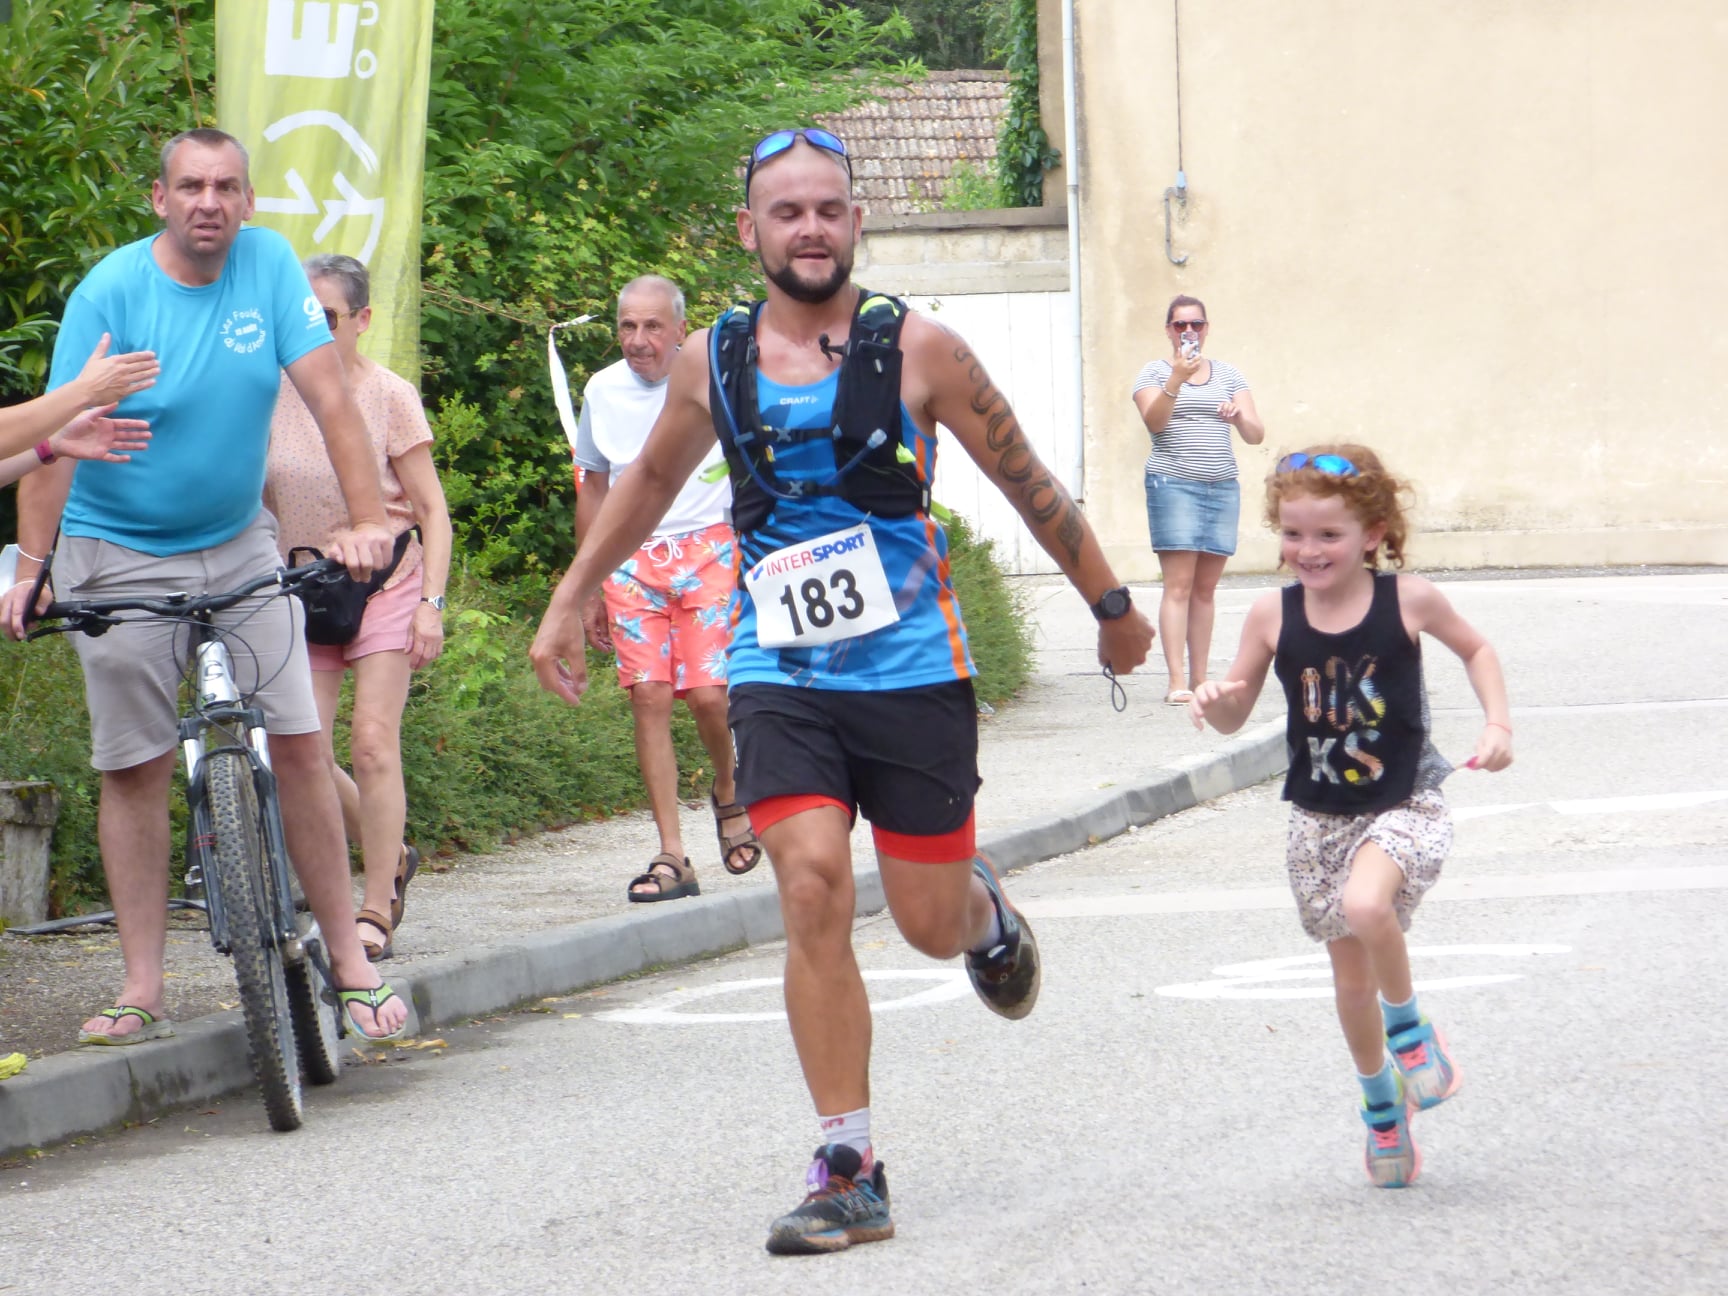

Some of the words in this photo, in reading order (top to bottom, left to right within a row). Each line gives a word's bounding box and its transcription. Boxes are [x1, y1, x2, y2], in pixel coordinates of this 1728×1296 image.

[779, 395, 811, 405] CRAFT
[766, 532, 866, 577] INTERSPORT
[779, 568, 865, 637] 183
